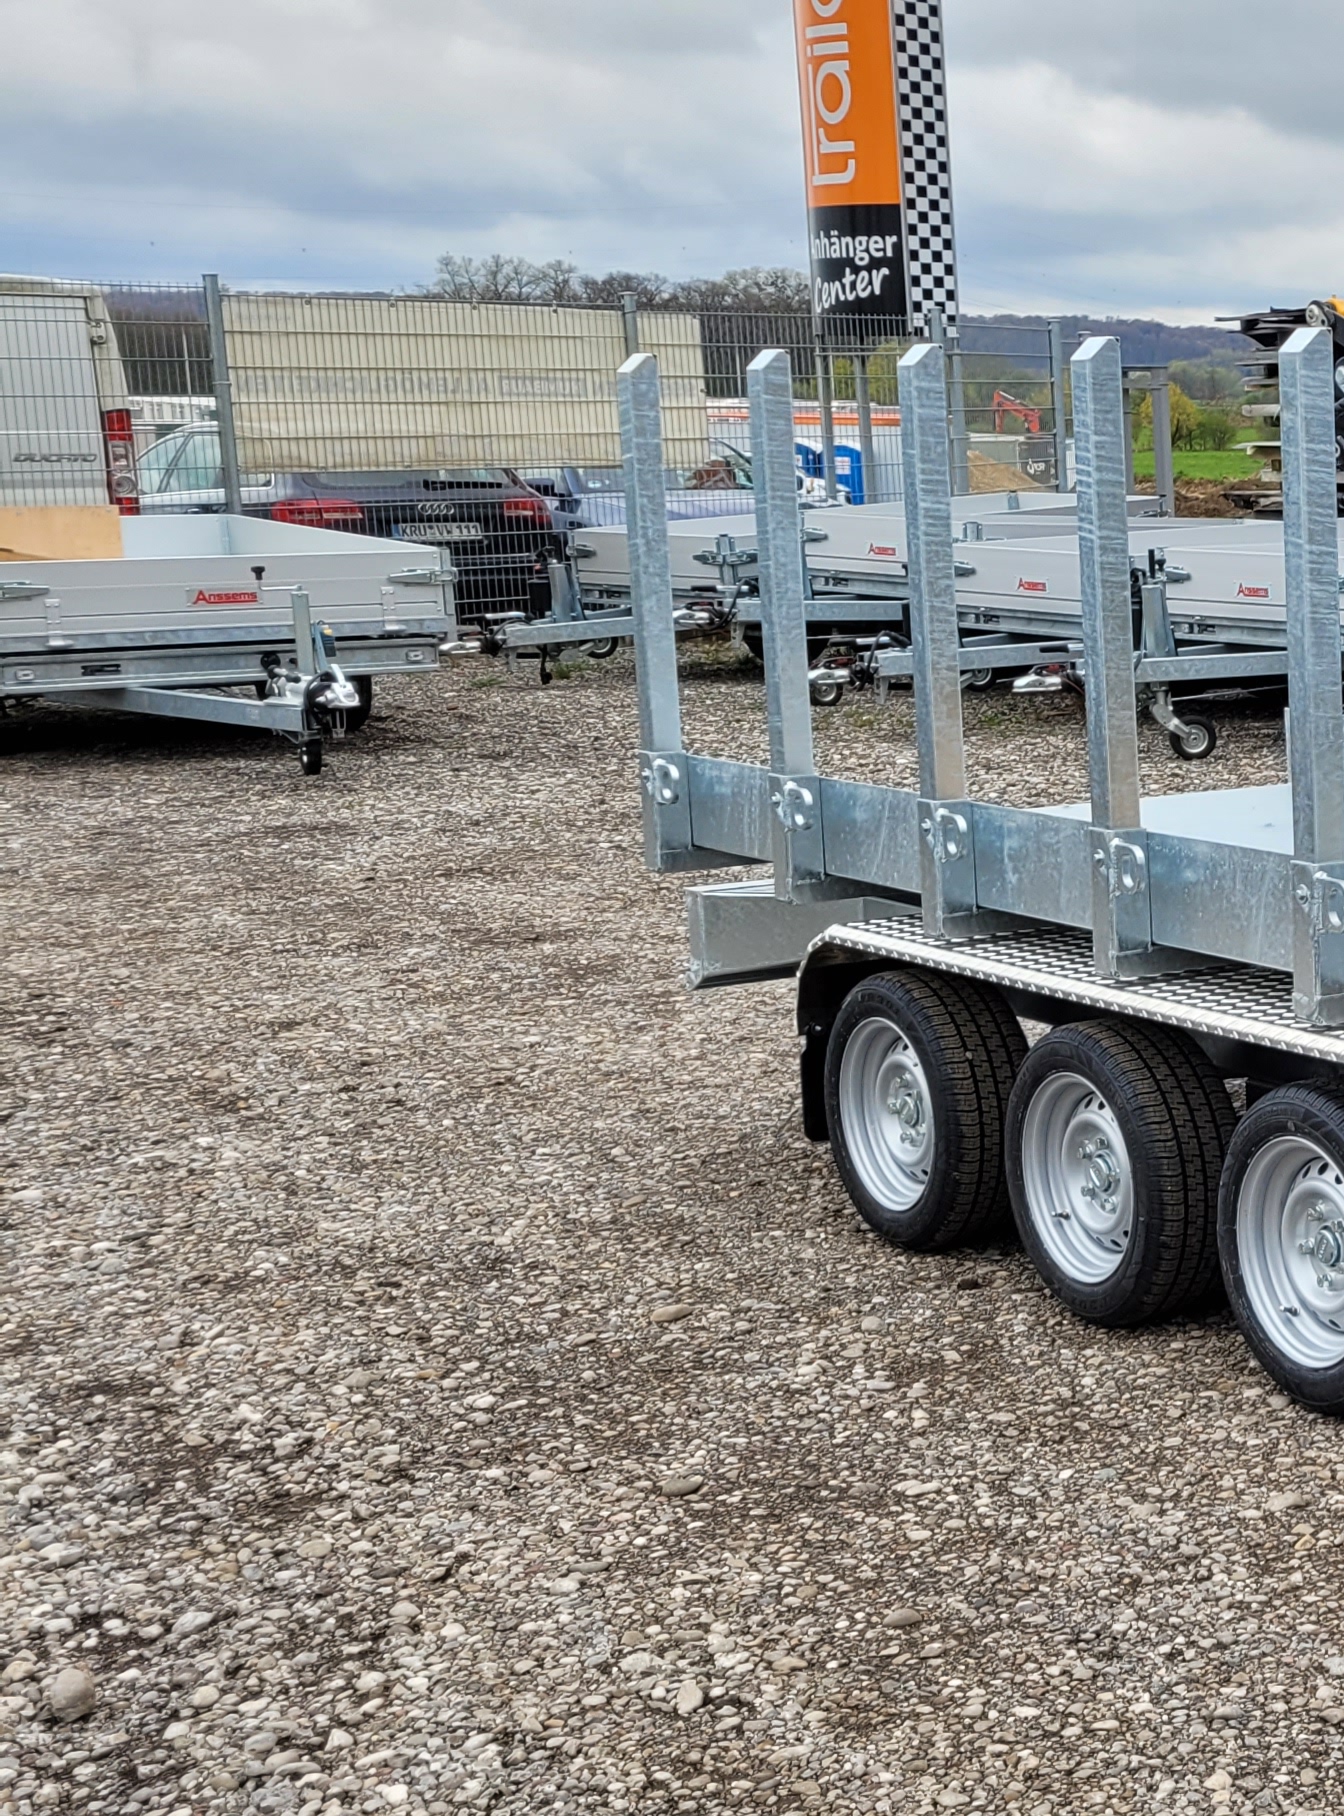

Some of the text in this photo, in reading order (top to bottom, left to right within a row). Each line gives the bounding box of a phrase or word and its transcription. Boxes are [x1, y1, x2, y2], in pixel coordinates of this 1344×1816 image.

[805, 0, 856, 187] trail
[811, 229, 898, 266] nhänger
[813, 267, 890, 314] Center
[193, 589, 258, 605] Anssems
